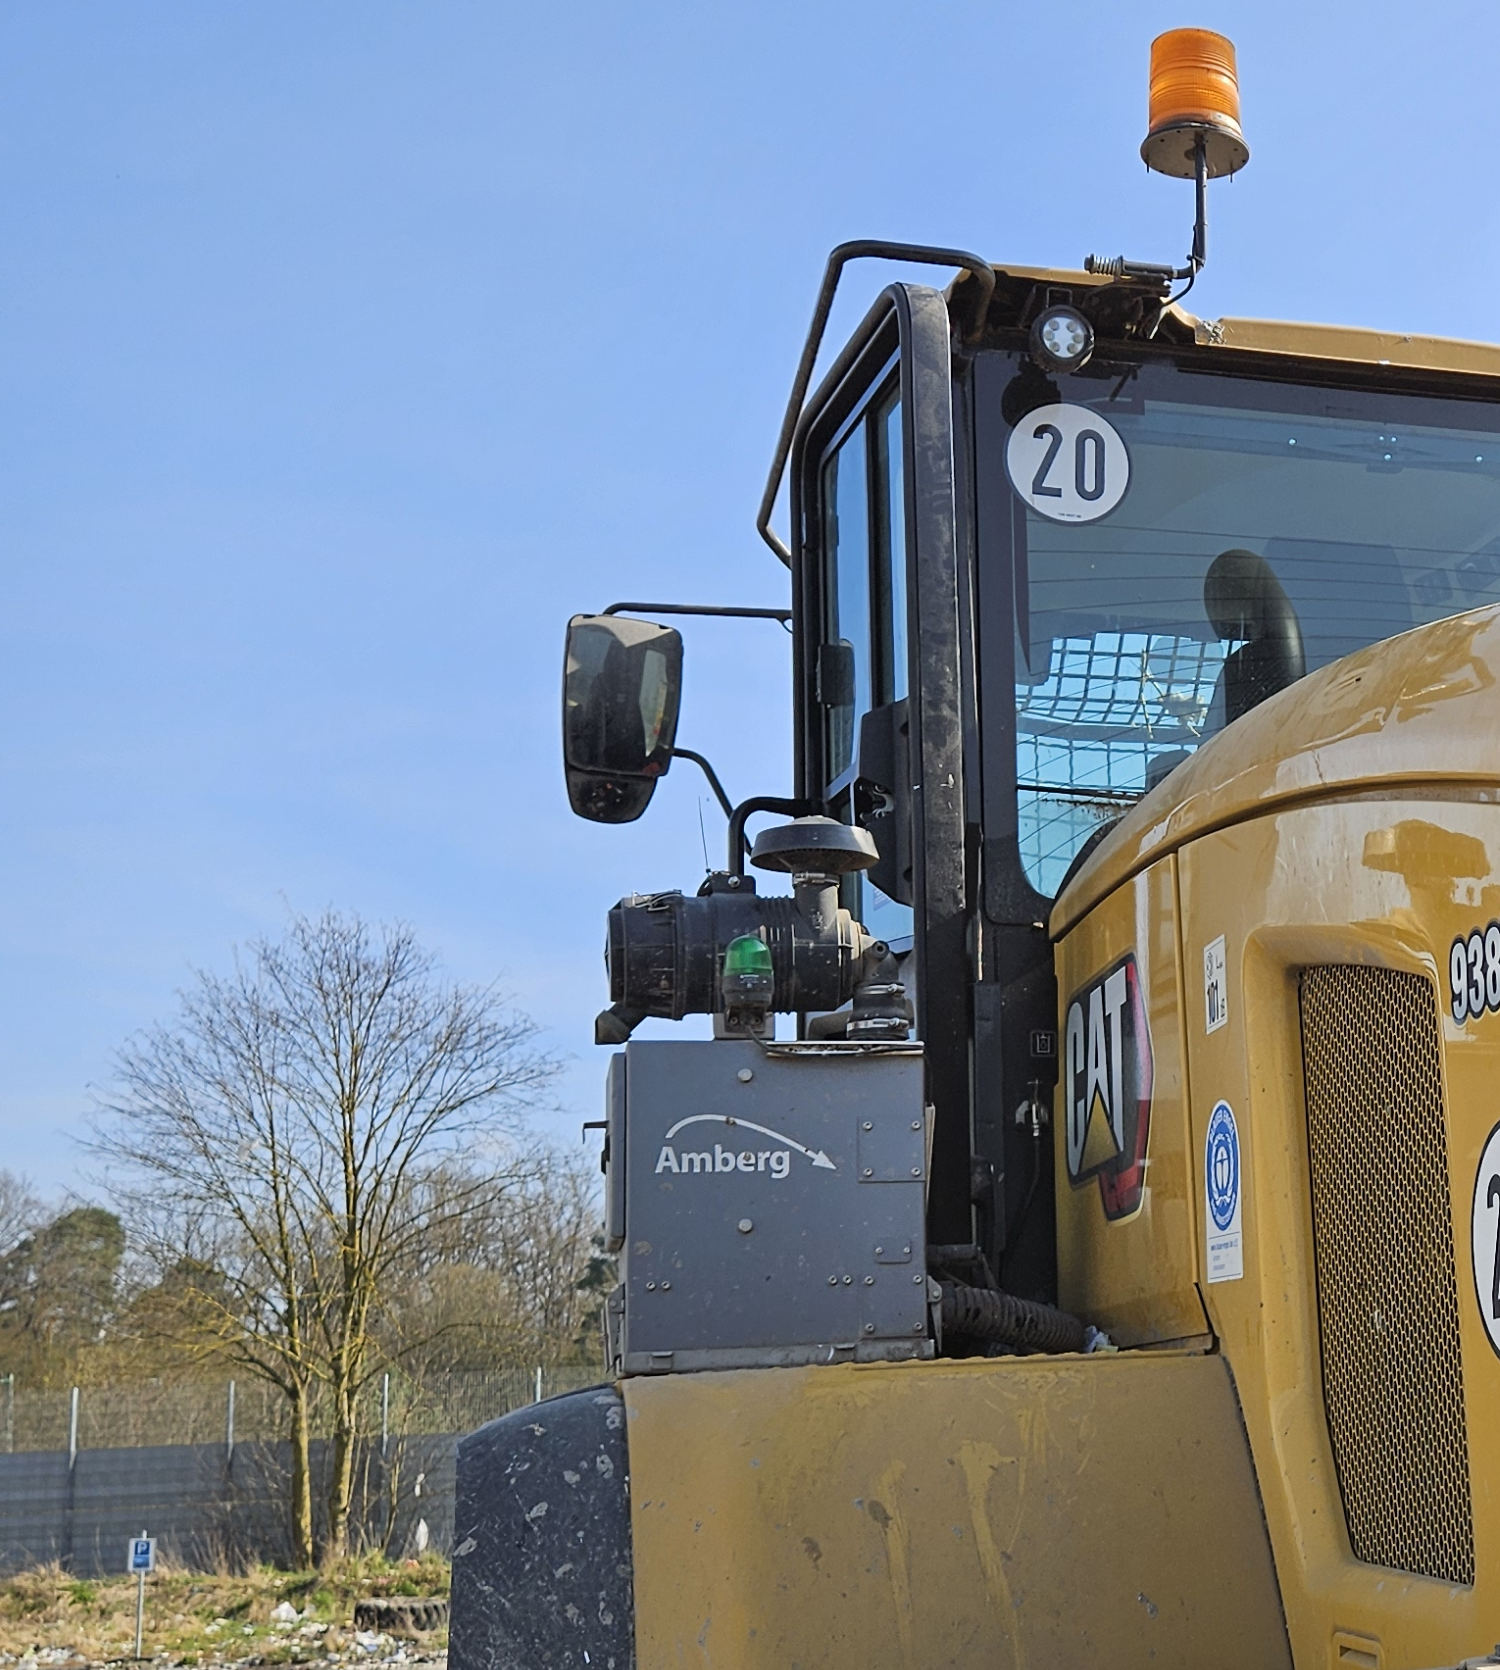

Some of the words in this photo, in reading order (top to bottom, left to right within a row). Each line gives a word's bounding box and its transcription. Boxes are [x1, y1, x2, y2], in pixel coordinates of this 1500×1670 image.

[1032, 424, 1105, 501] 20
[1066, 965, 1127, 1176] CAT
[655, 1143, 790, 1179] Amberg
[137, 1541, 148, 1555] P
